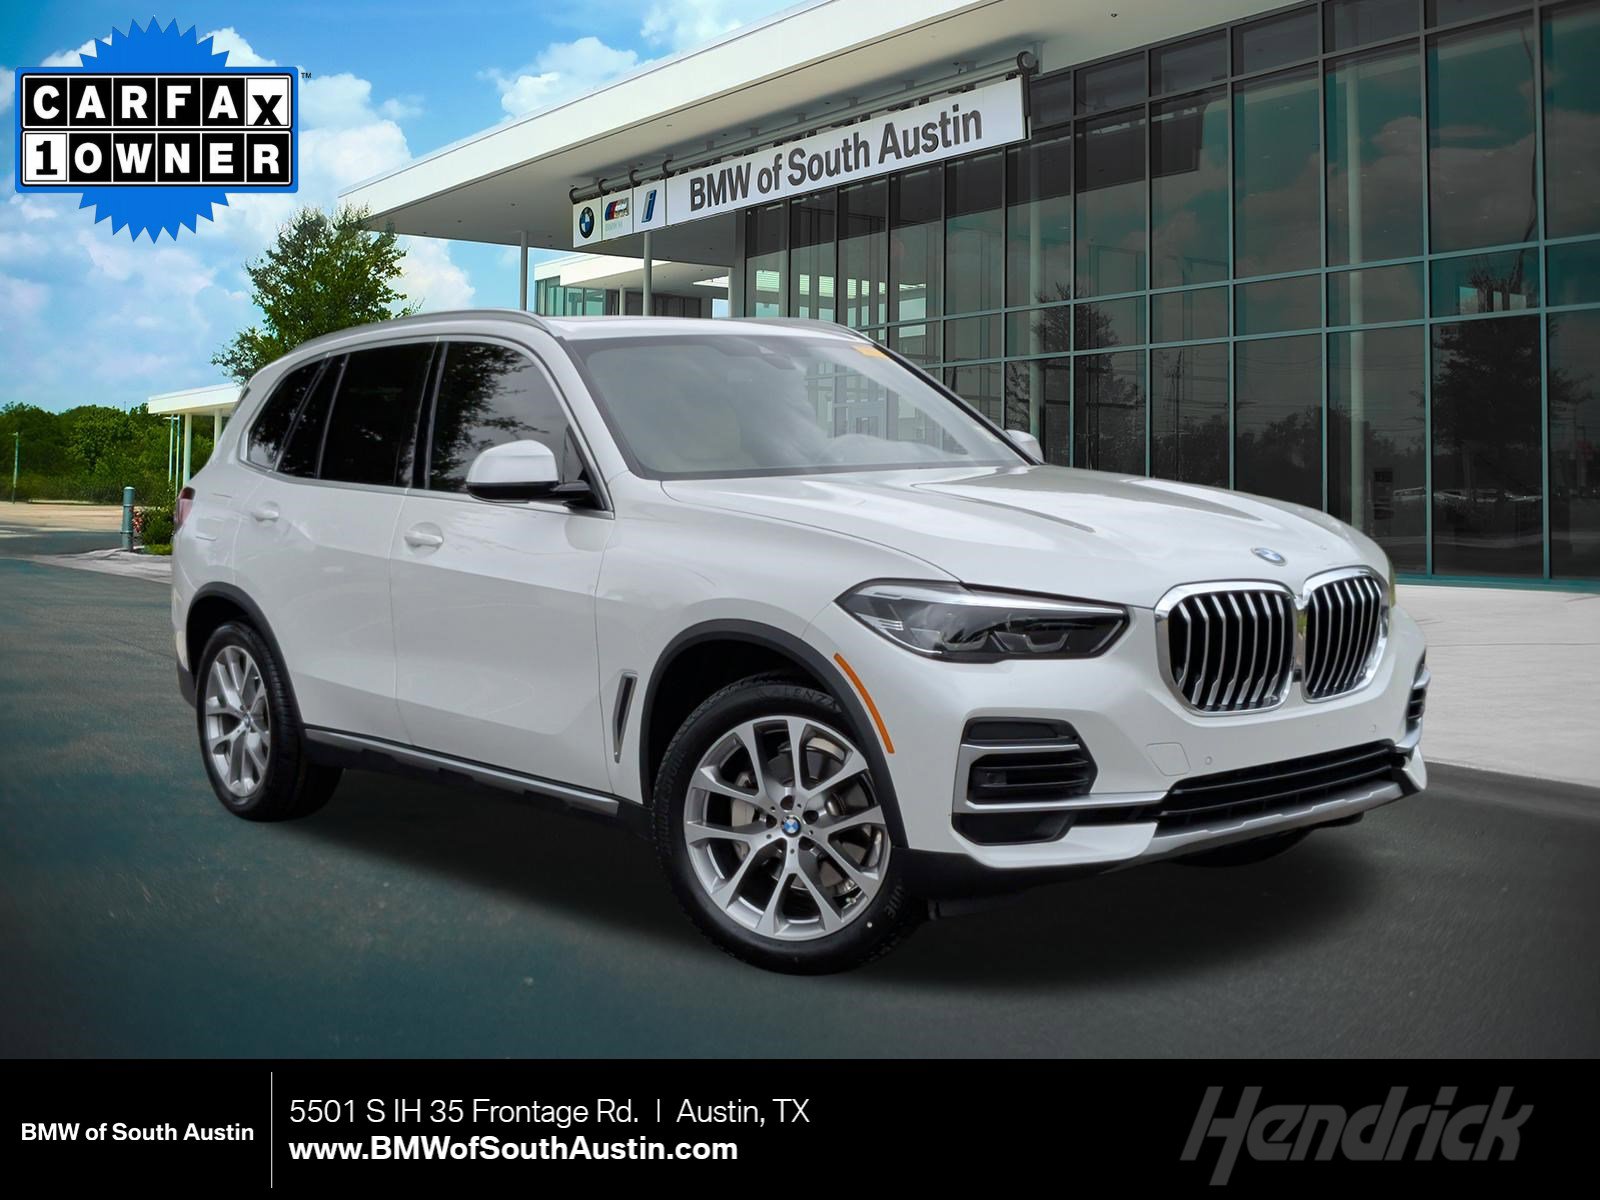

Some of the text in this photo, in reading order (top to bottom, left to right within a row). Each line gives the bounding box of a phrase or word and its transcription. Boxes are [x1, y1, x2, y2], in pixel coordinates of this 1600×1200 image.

[690, 162, 751, 212] BMW
[757, 153, 783, 194] of
[787, 131, 871, 187] South
[878, 103, 983, 164] Austin
